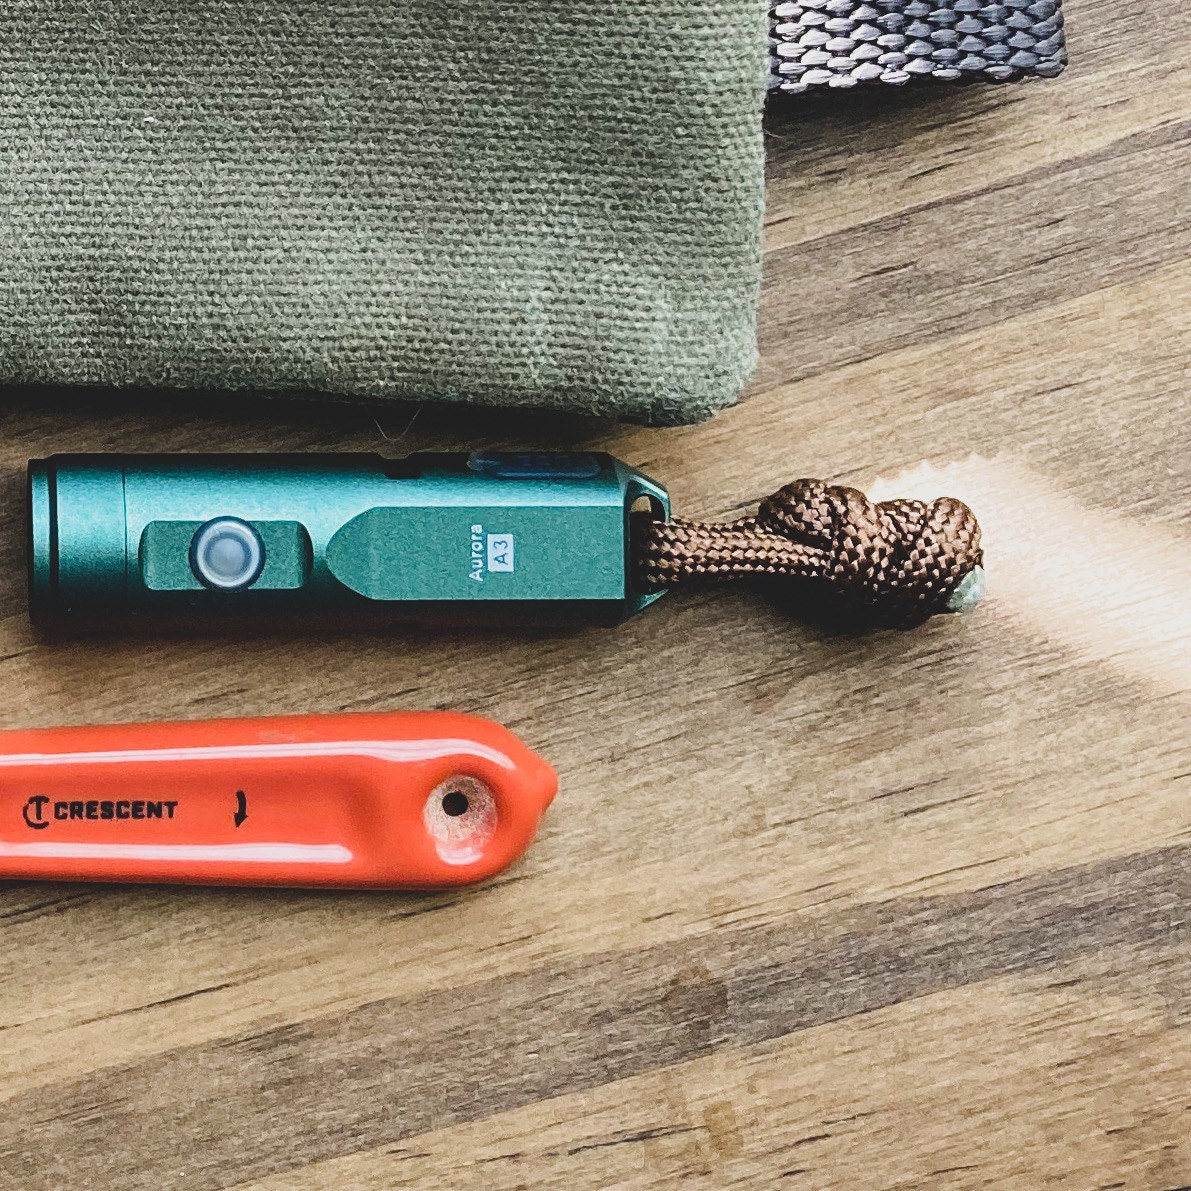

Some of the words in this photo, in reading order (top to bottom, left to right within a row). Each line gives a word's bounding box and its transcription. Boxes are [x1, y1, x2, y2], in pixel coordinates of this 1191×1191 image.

[468, 524, 484, 582] Aurora
[493, 540, 509, 565] A3
[53, 800, 179, 821] CRESCENT
